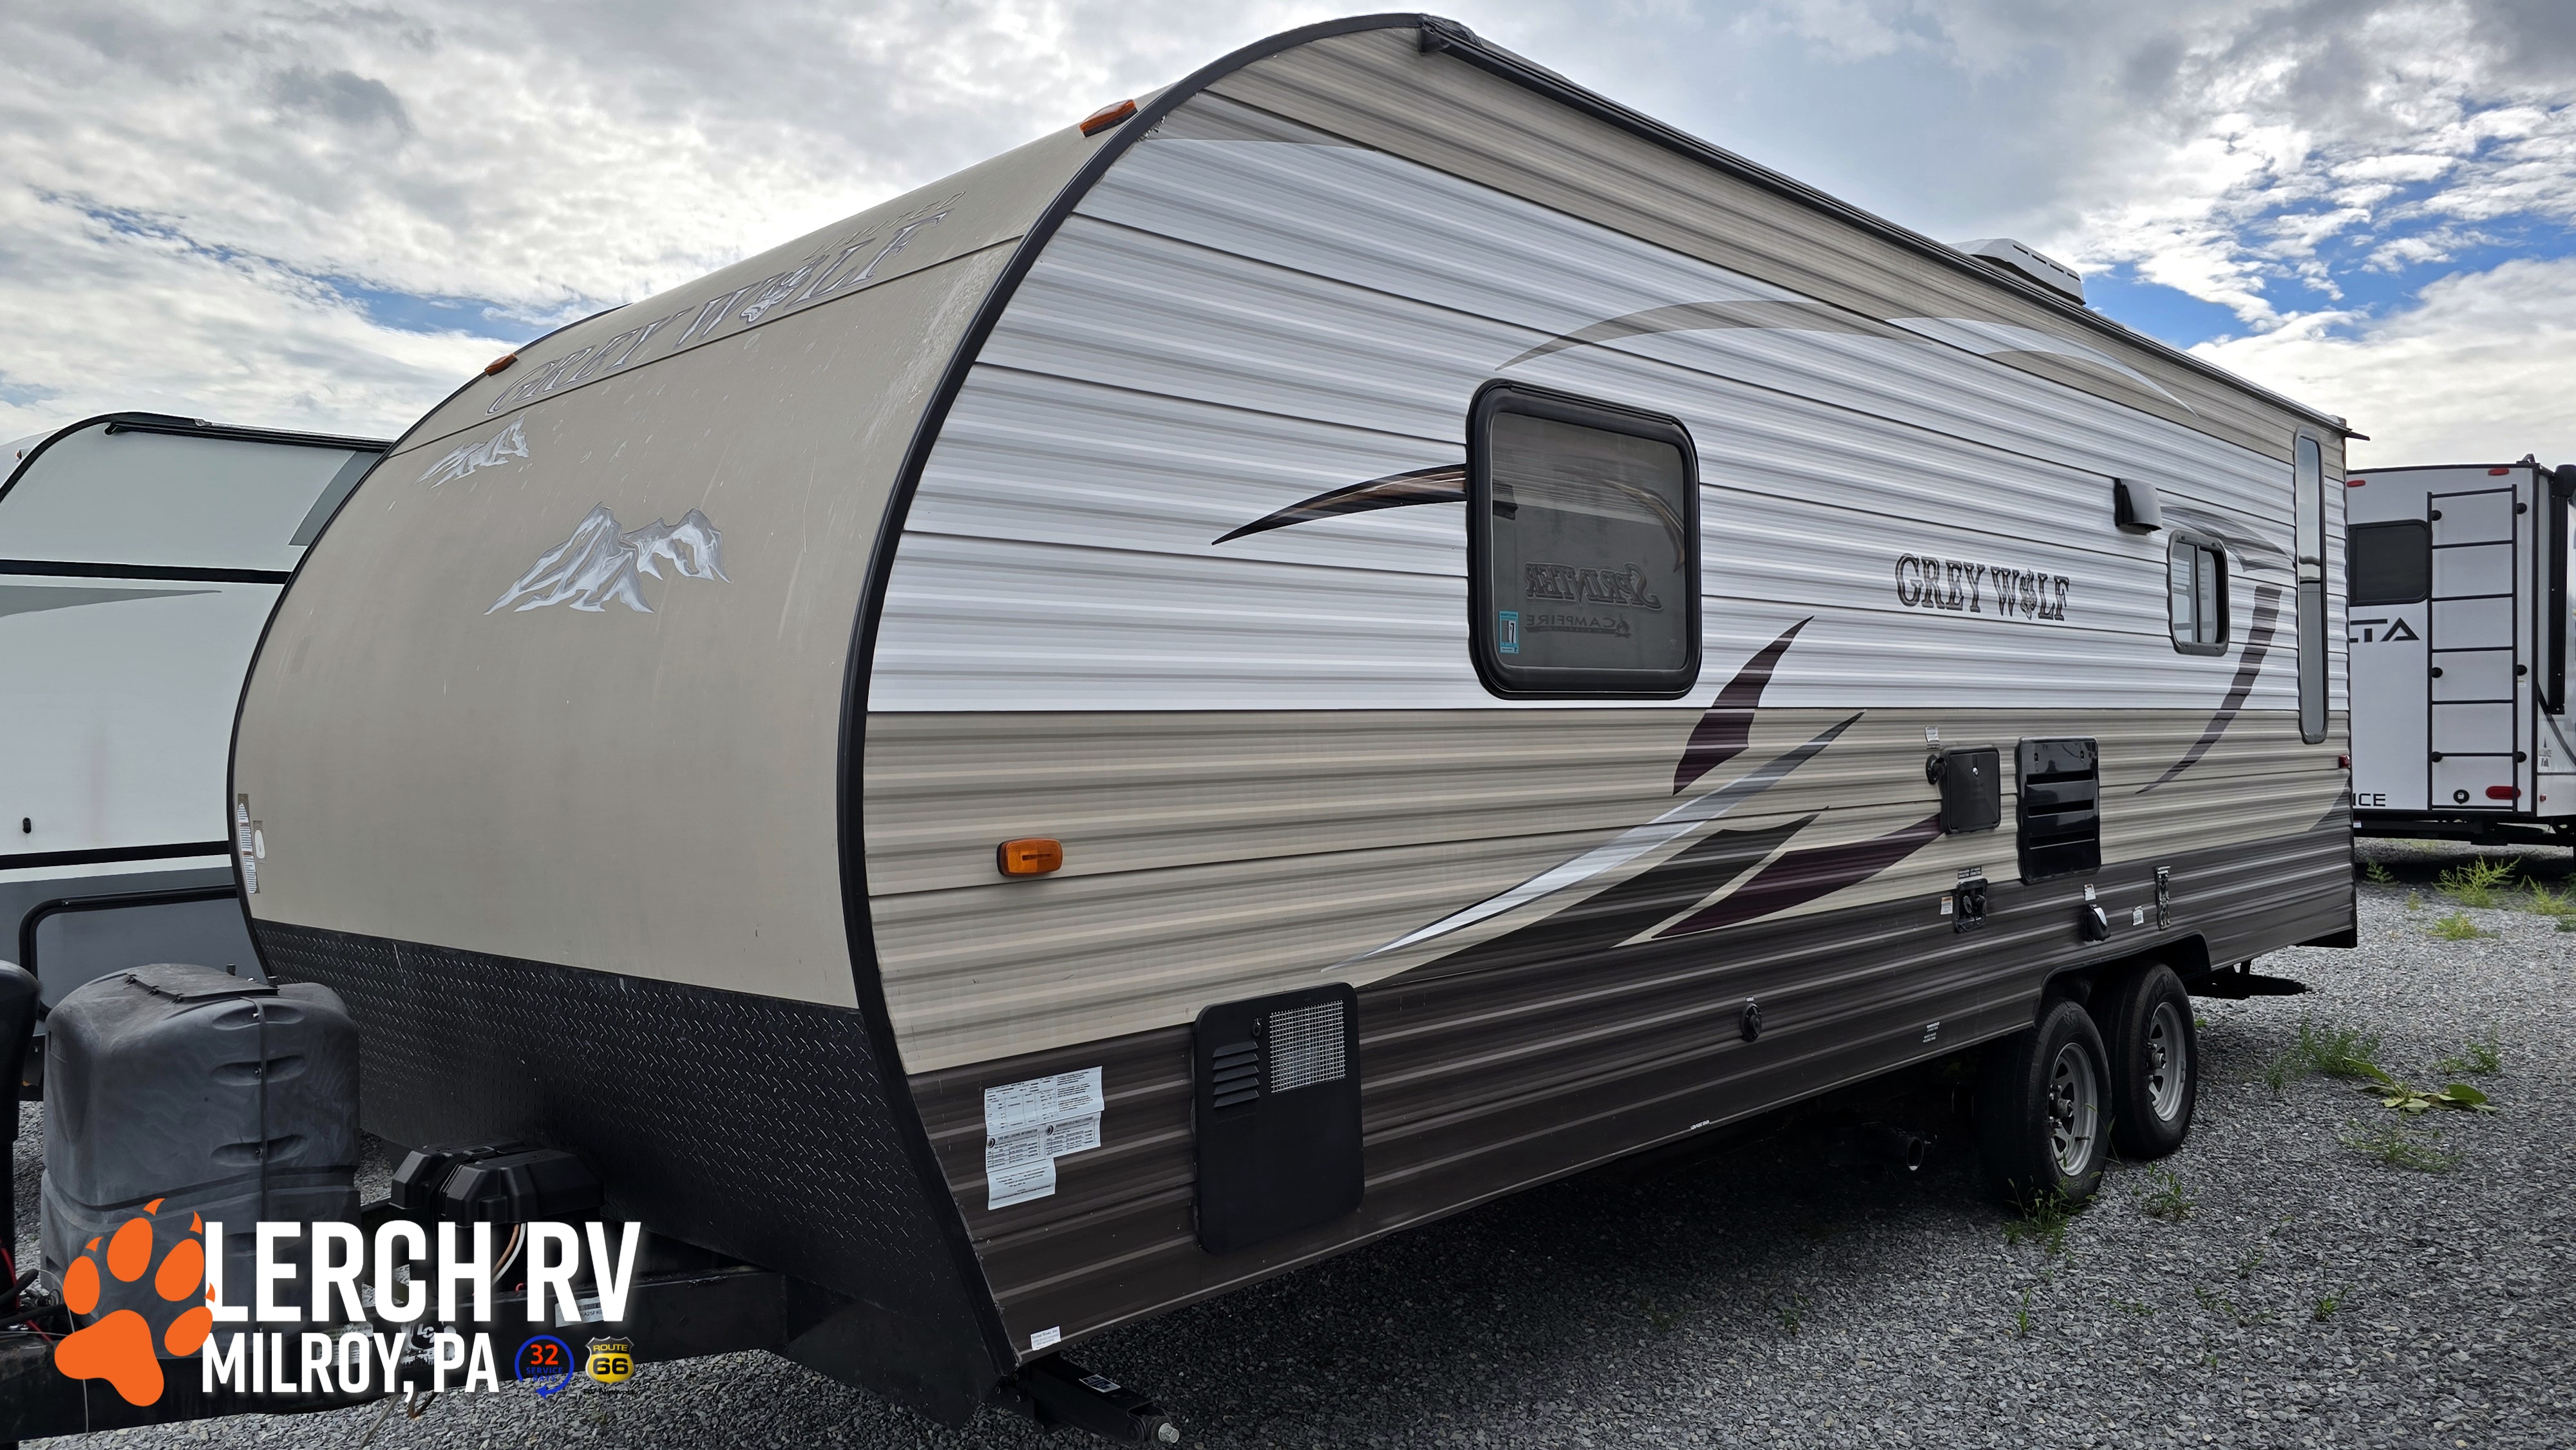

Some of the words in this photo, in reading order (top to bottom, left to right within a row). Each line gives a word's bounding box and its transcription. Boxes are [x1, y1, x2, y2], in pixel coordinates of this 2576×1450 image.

[803, 191, 965, 261] LIMITED
[484, 306, 696, 417] GREY
[1895, 552, 1985, 613] GREY
